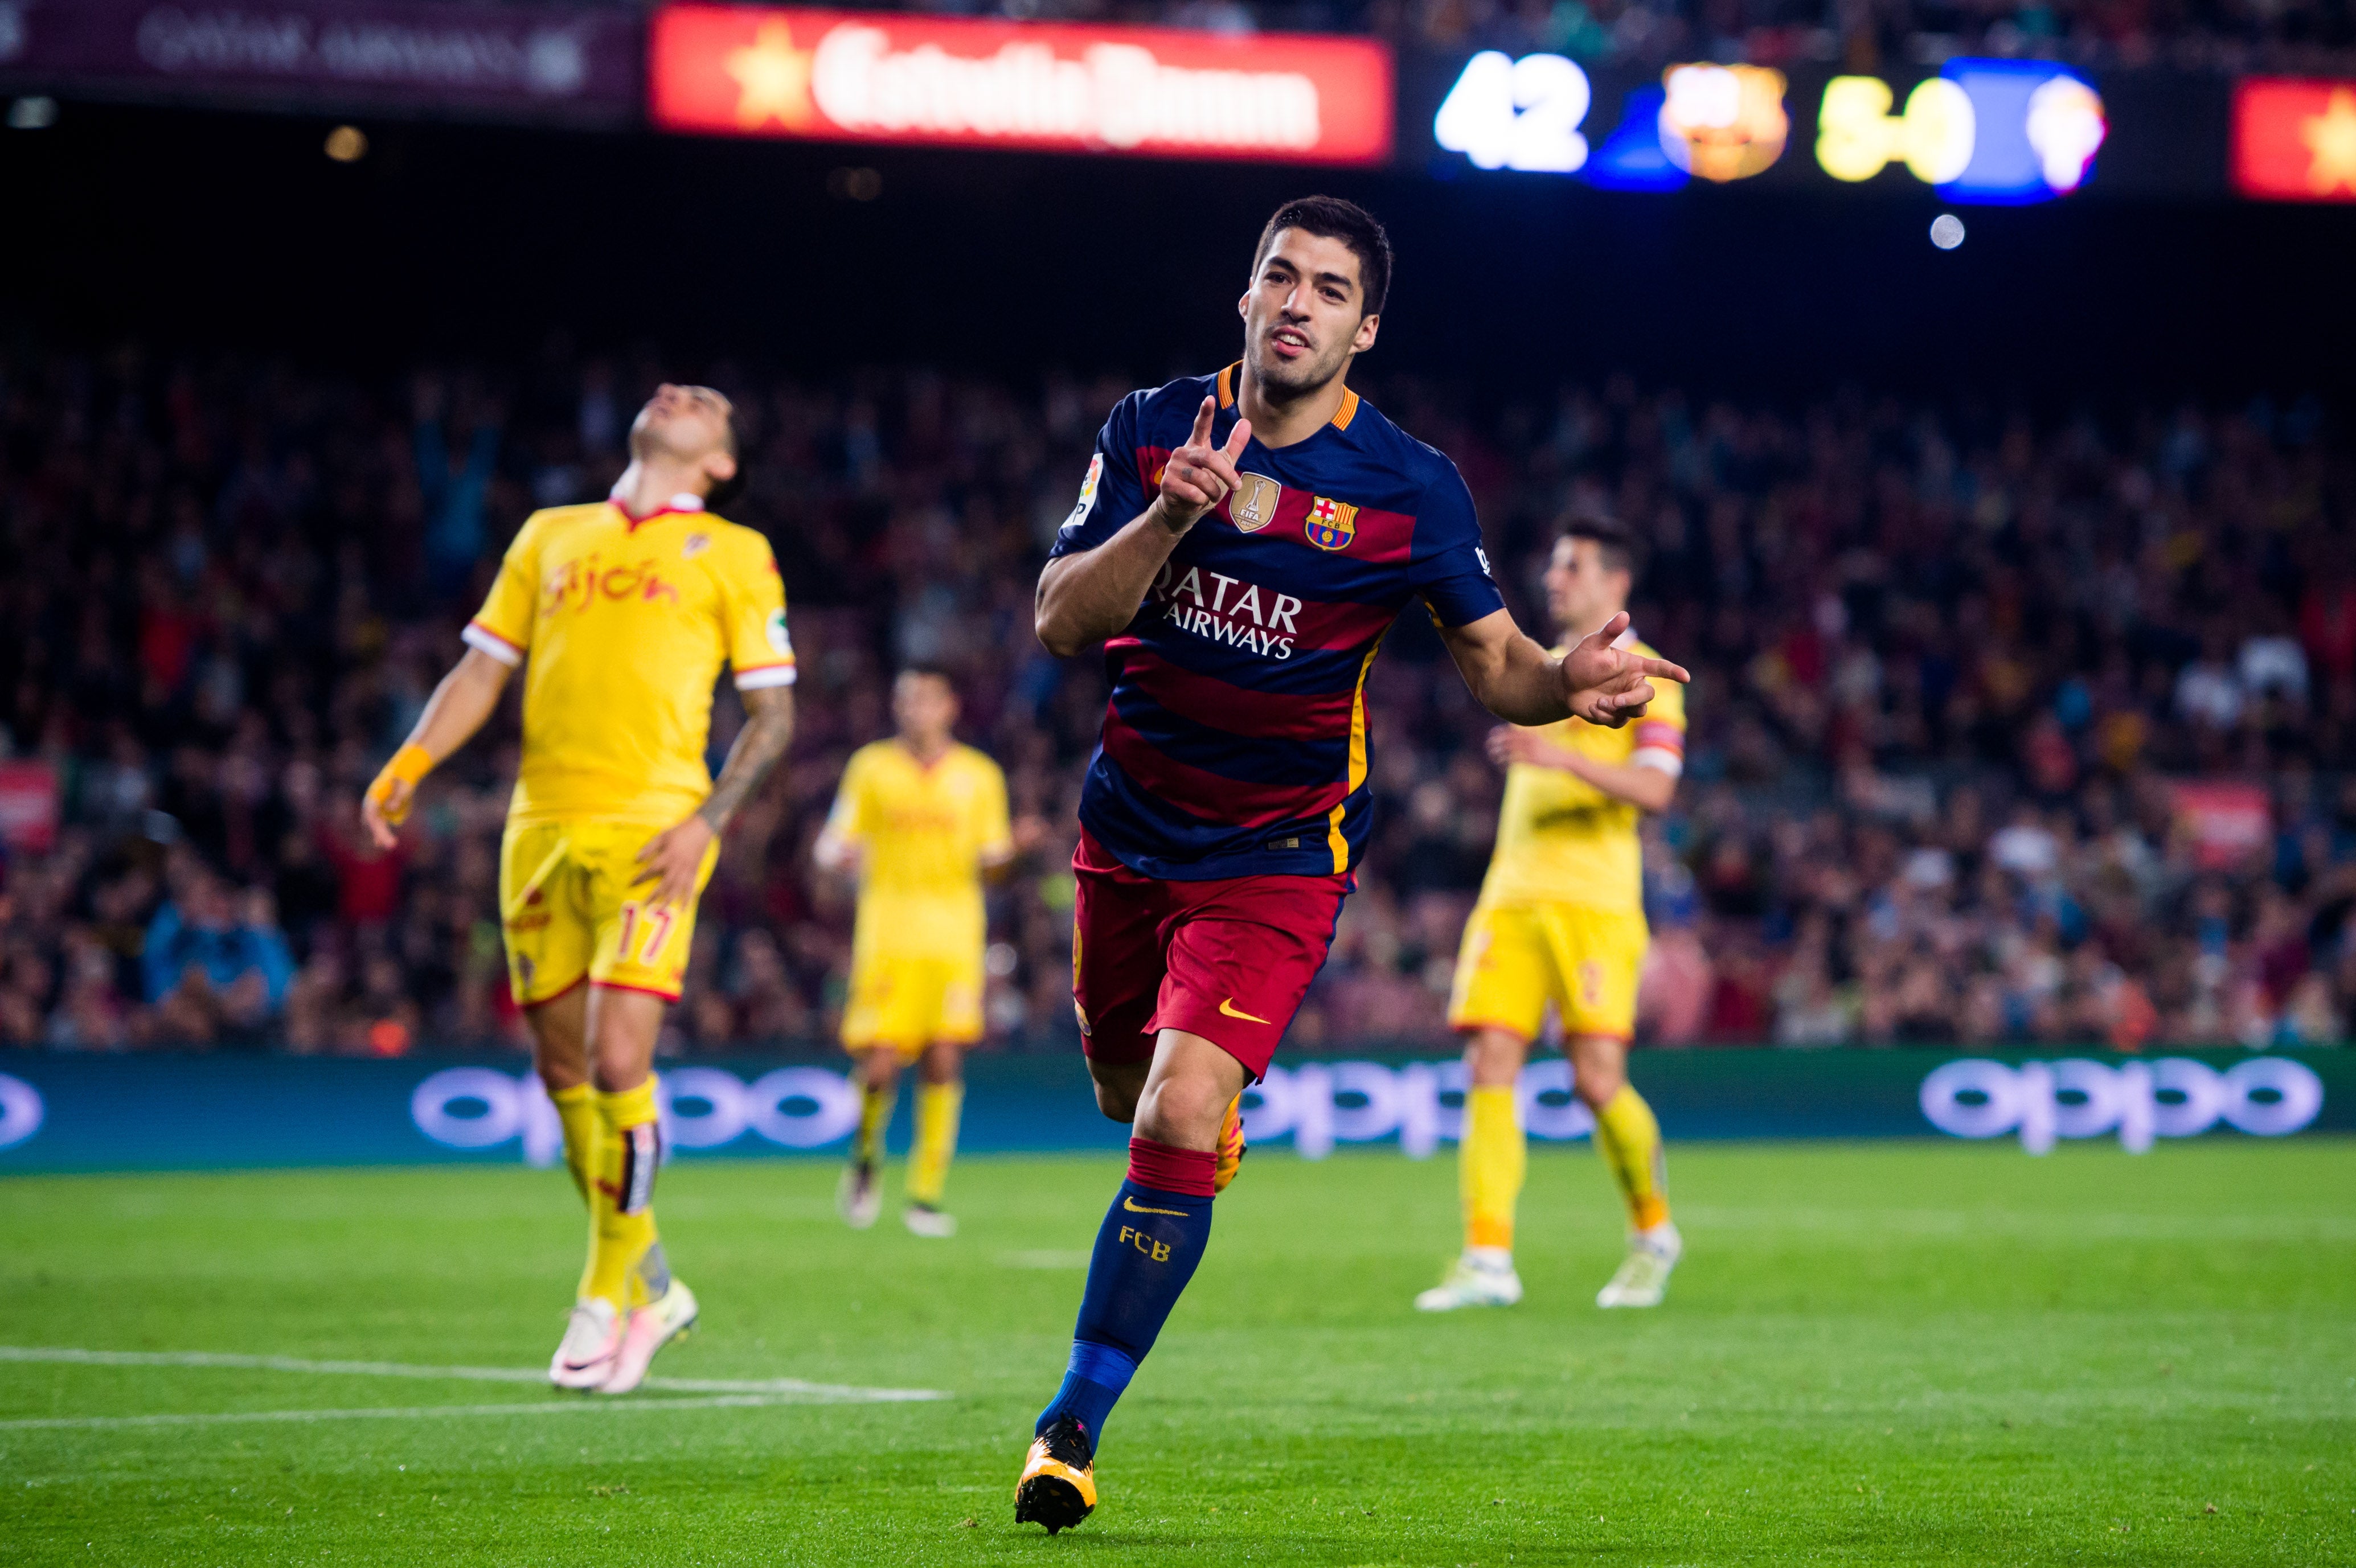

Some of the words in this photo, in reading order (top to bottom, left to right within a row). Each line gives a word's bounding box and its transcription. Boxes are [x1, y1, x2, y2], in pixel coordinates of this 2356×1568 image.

[1435, 50, 1589, 172] 42
[1240, 509, 1259, 521] FIFA
[1322, 519, 1340, 529] FCB
[1163, 602, 1294, 659] AIRWAYS
[620, 900, 677, 967] 17
[1919, 1057, 2325, 1157] oppo
[1119, 1225, 1171, 1262] FCB
